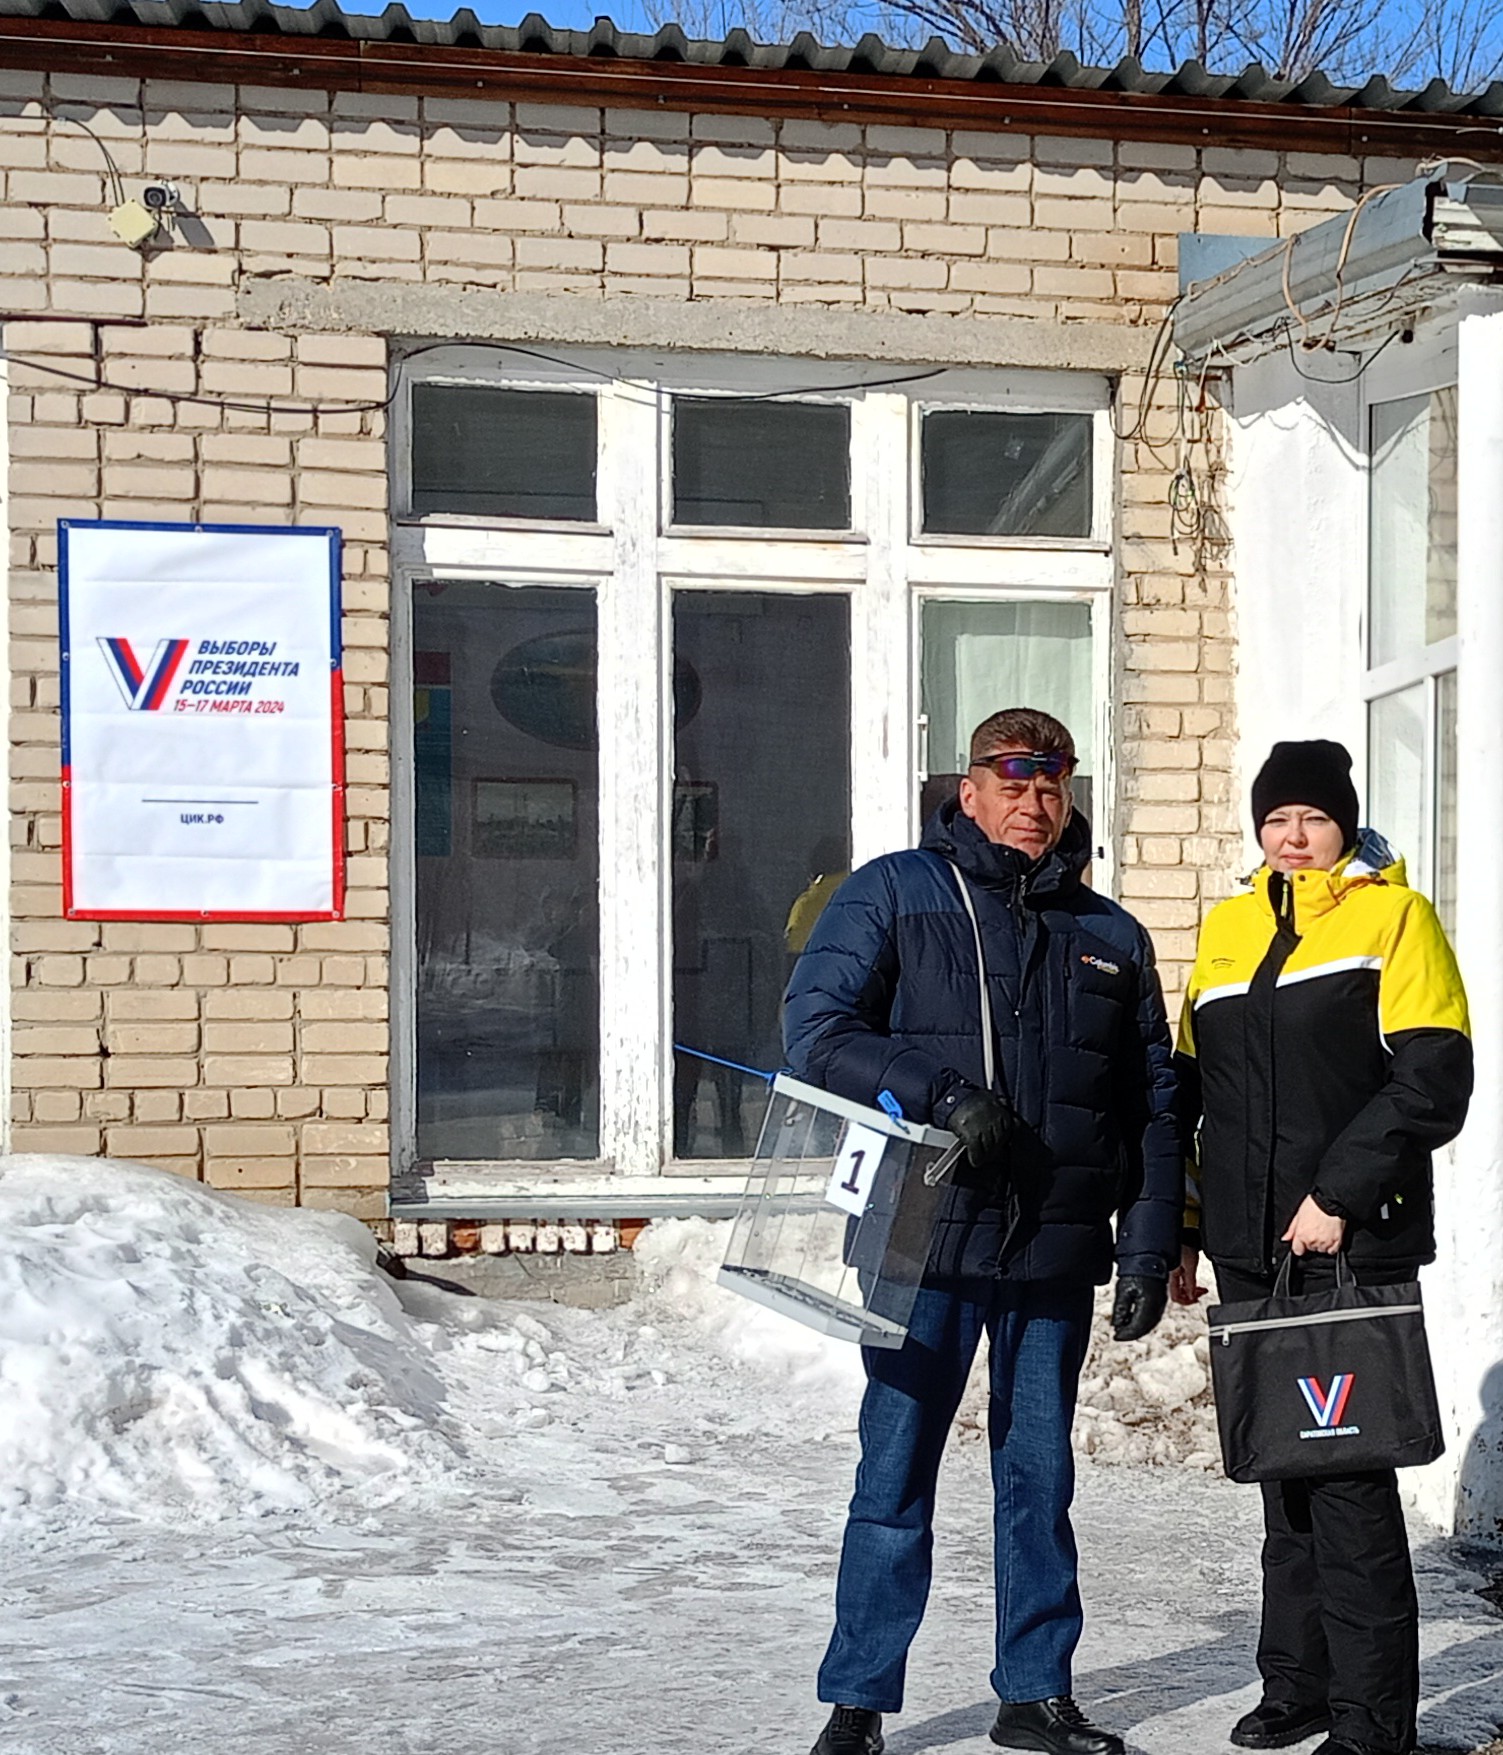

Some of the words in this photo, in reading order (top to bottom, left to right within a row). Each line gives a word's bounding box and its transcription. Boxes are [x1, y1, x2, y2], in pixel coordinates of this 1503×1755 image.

[198, 640, 277, 656] ВЫБОРЫ
[188, 660, 300, 678] ПРЕЗИДЕНТА
[179, 680, 252, 695] РОССИИ
[209, 699, 253, 713] МАРТА
[254, 700, 285, 714] 2024
[180, 813, 224, 826] ЦИК.РФ
[841, 1149, 866, 1195] 1
